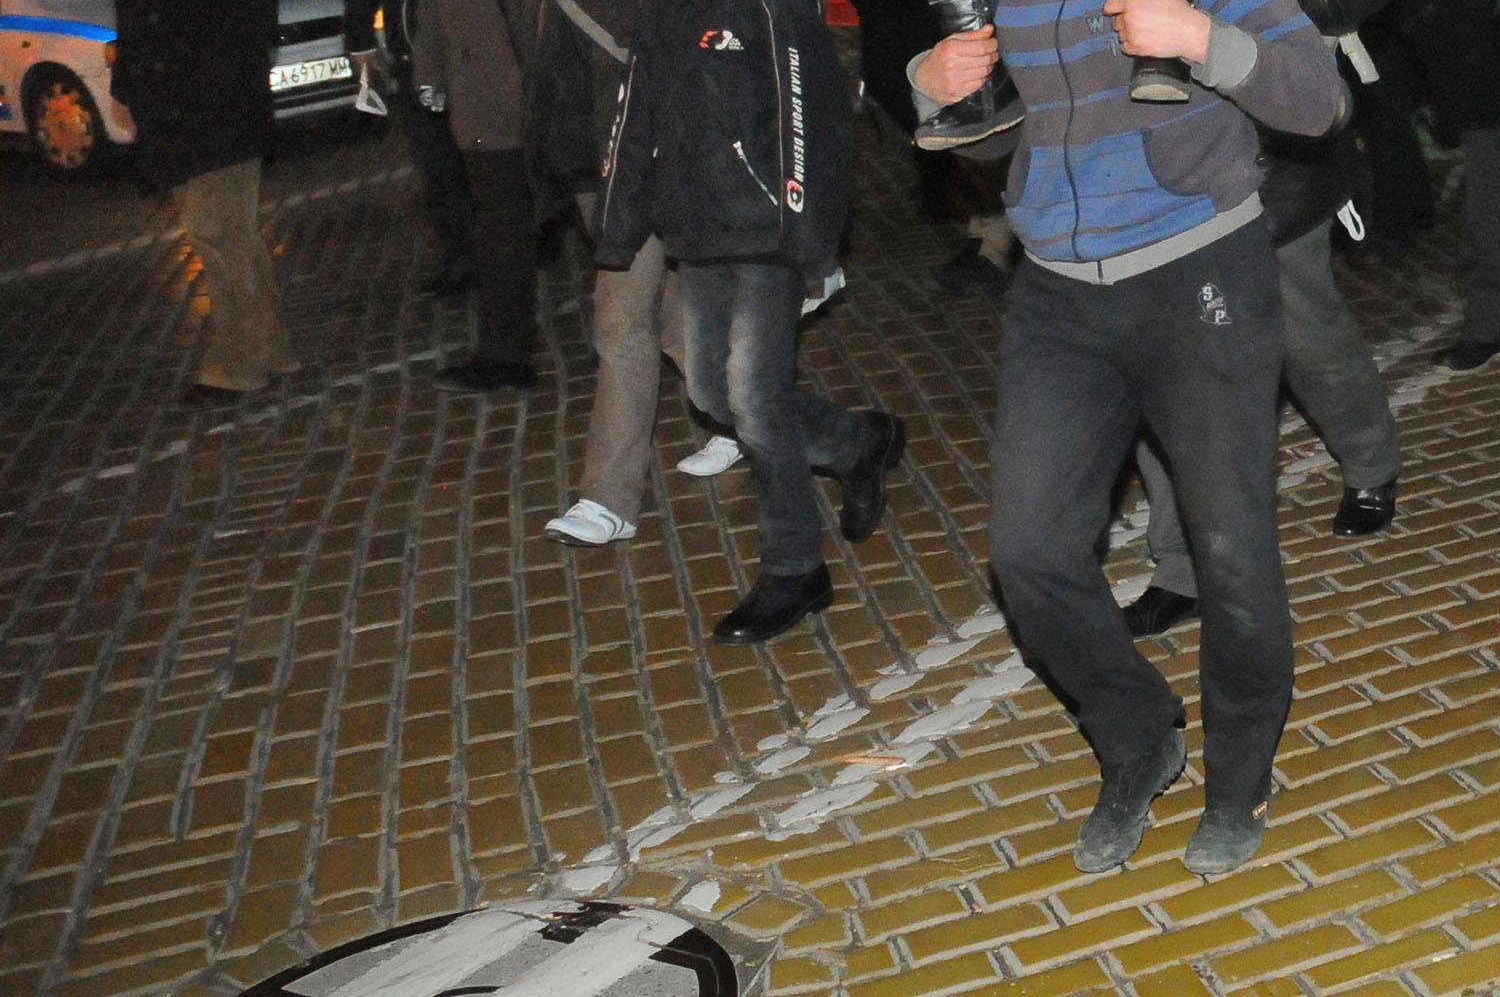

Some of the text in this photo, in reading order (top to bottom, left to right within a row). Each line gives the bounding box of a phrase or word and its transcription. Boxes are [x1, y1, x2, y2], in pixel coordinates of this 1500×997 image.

[788, 46, 805, 183] ITALIAN SPORT DESIGN
